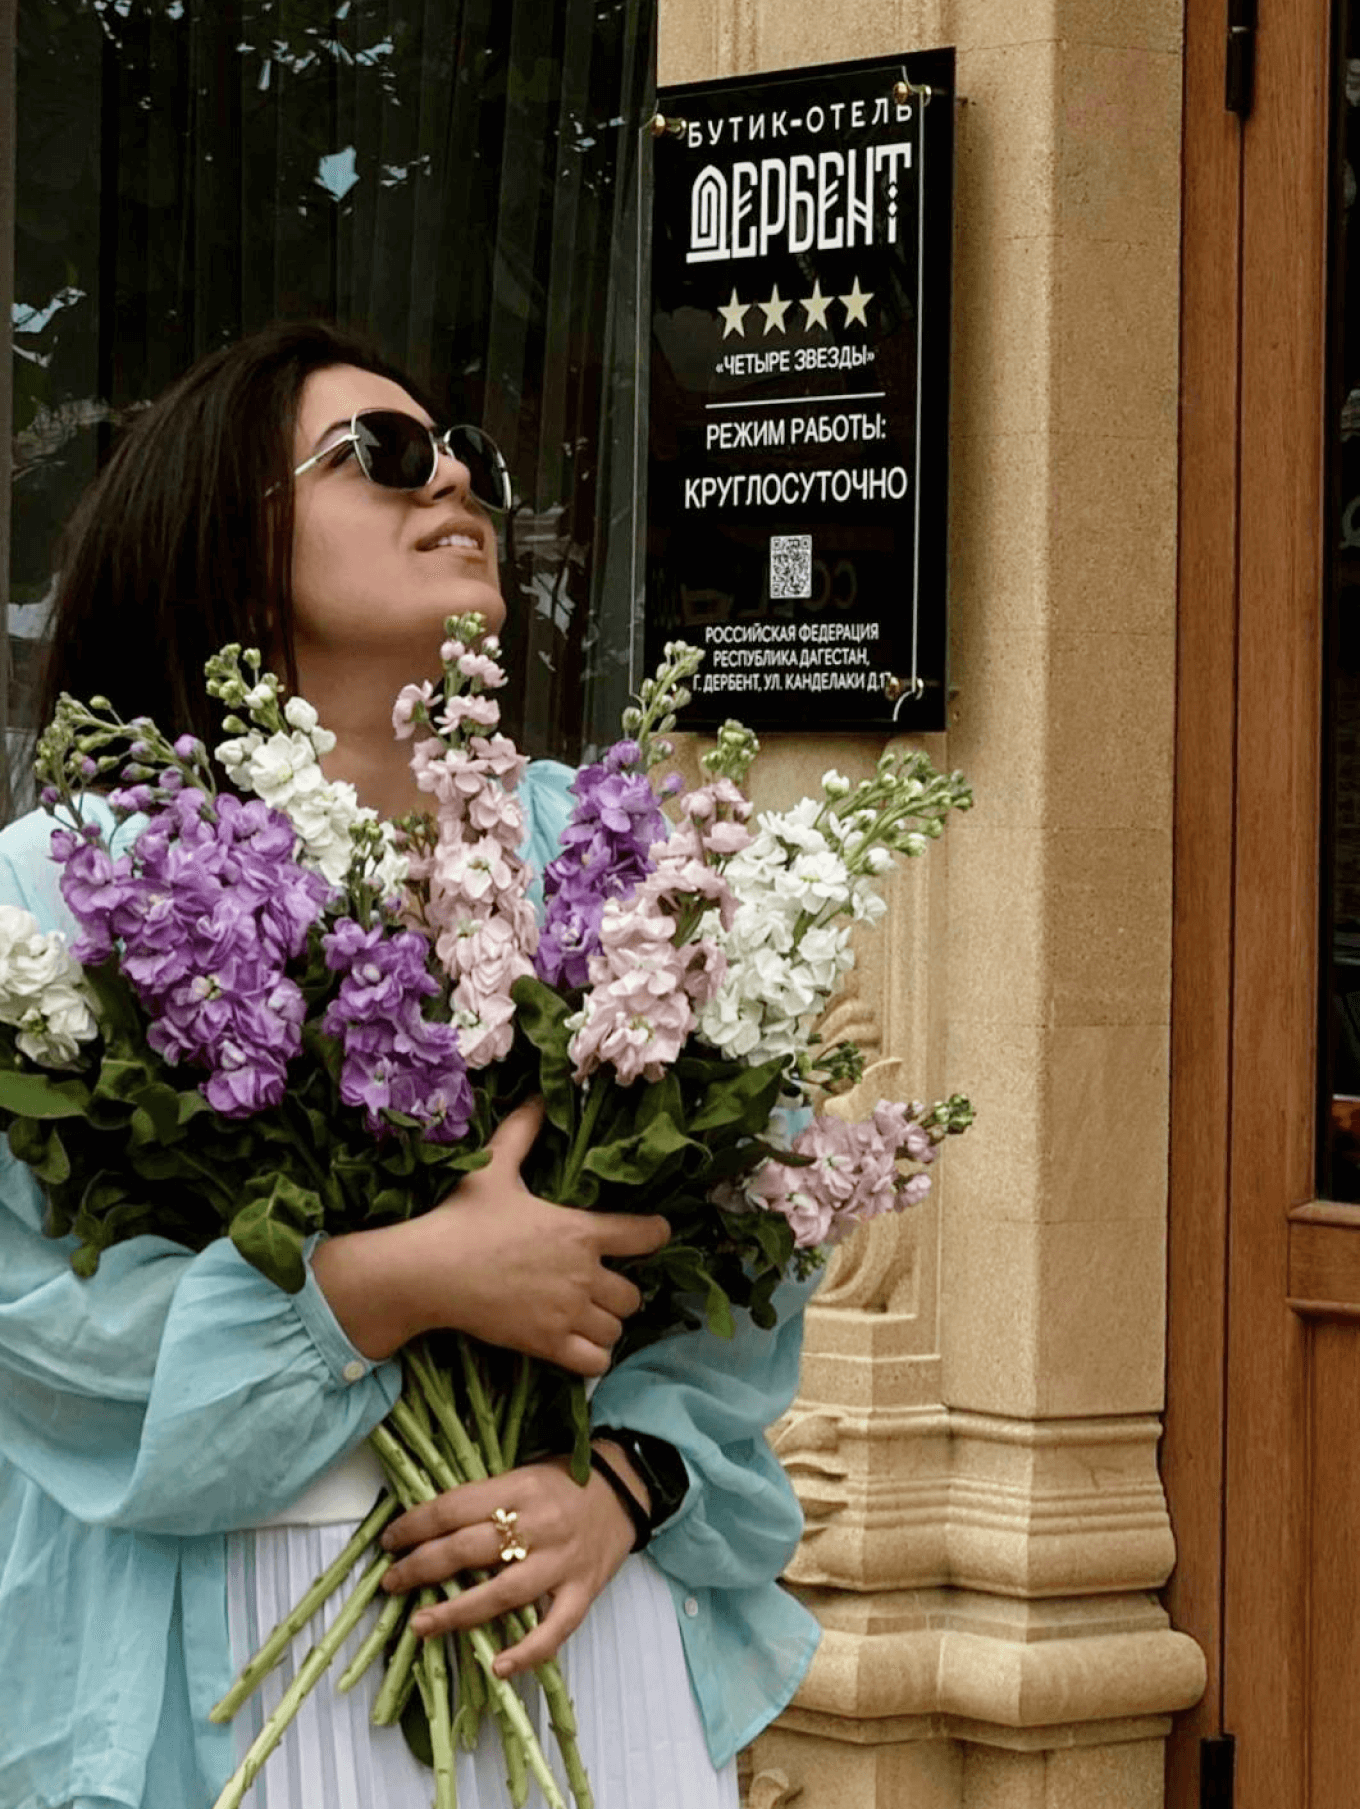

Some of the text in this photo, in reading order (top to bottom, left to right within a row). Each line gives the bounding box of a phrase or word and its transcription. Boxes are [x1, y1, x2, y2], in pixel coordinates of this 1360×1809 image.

[688, 97, 913, 148] БУТИК-ОТЕЛЬ
[686, 141, 912, 264] ДЕРБЕНТ
[715, 344, 876, 375] «ЧЕТЫРЕ ЗВЕЗДЫ»
[706, 412, 887, 451] РЕЖИМ РАБОТЫ:
[684, 466, 908, 510] КРУГЛОСУТОЧНО
[705, 622, 879, 644] РОССИЙСКАЯ ФЕДЕРАЦИЯ
[713, 647, 870, 668] РЕСПУБЛИКА ДАГЕСТАН,
[702, 673, 763, 692] ДЕРБЕНТ,
[764, 673, 783, 691] УЛ.
[784, 672, 866, 692] КАНДЕЛАКИ
